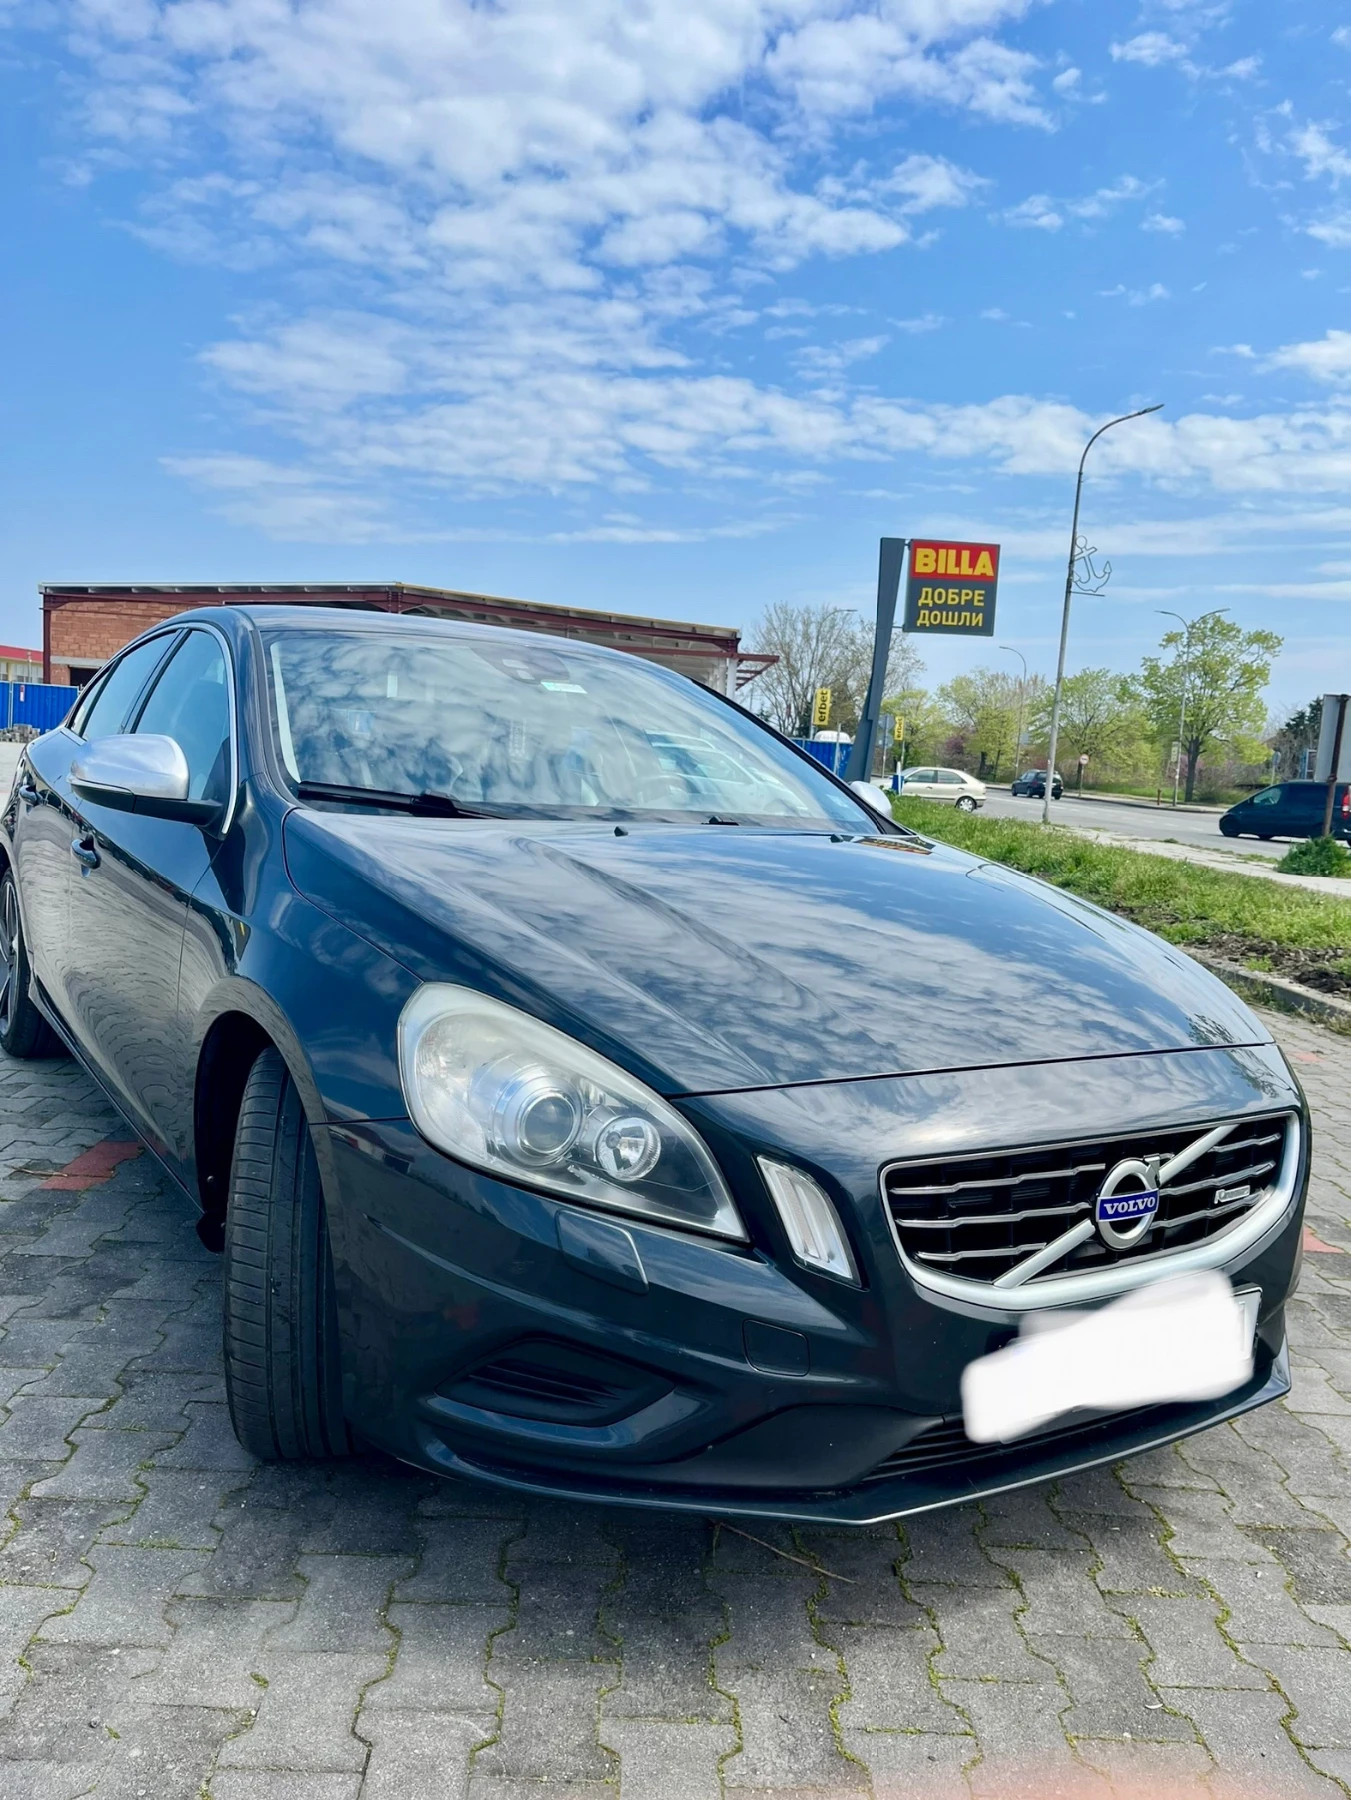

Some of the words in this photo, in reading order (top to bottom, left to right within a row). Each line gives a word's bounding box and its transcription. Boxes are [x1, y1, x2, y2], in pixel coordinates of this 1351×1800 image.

[915, 548, 994, 576] BILLA
[918, 588, 985, 607] ДОБРЕ
[917, 610, 983, 627] ДОШЛИ
[818, 690, 828, 722] efbet
[1104, 1196, 1156, 1215] VOLVO
